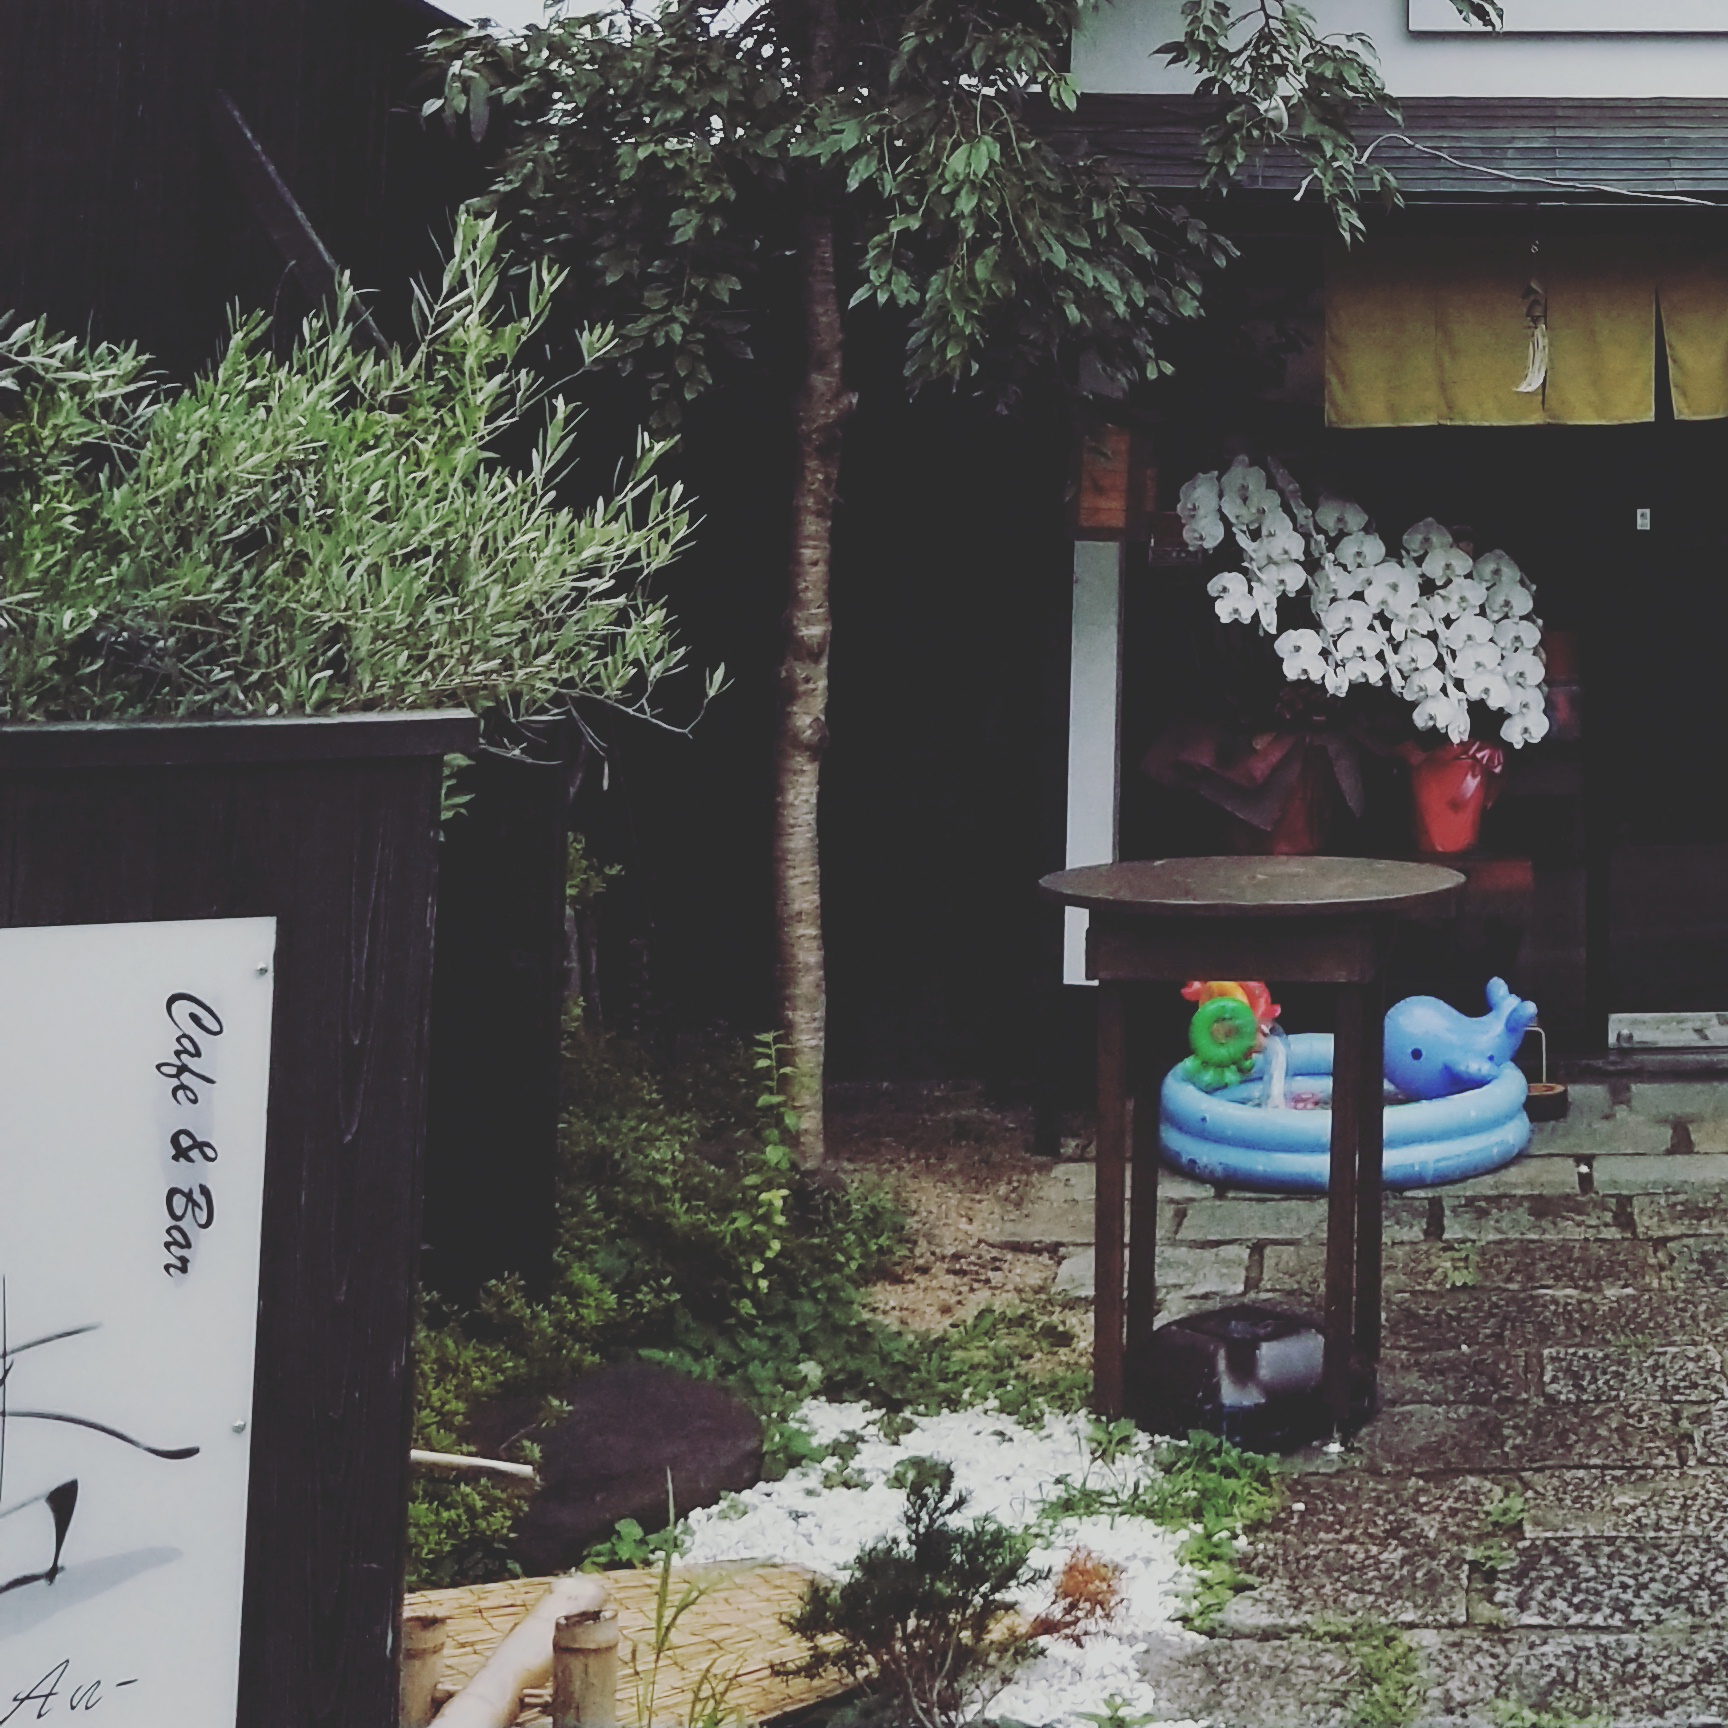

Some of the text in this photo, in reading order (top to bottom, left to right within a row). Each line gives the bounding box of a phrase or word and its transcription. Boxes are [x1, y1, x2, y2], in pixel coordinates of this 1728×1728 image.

[156, 993, 223, 1277] Cafe & Bar
